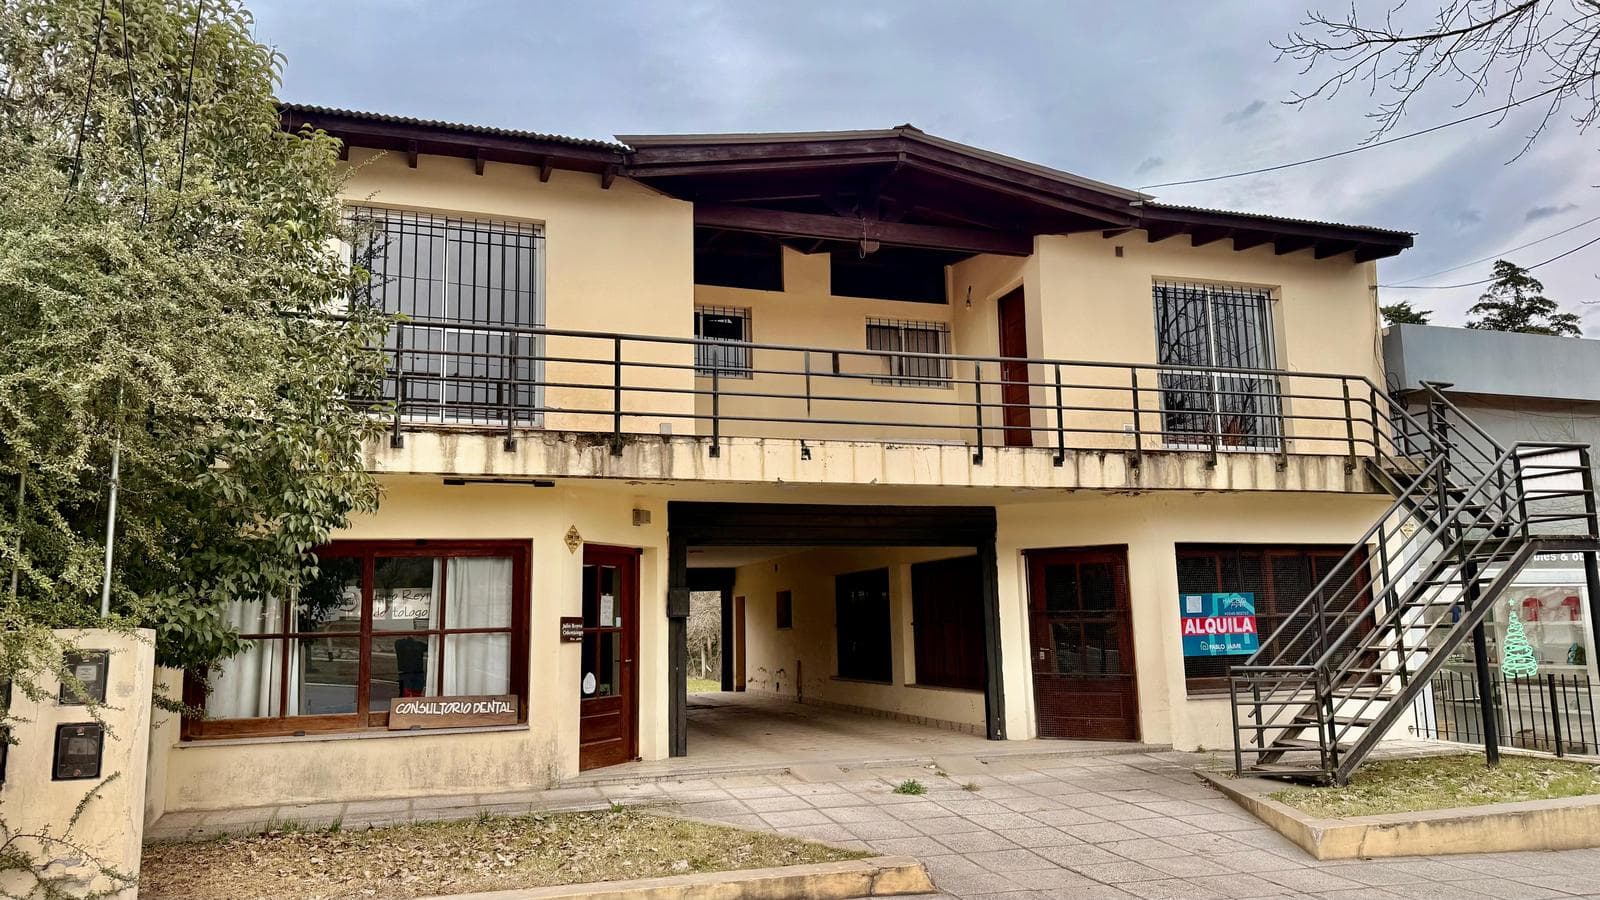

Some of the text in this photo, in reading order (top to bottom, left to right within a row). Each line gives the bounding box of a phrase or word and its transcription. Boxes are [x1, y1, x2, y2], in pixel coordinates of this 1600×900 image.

[402, 589, 432, 602] Reyn
[1185, 617, 1253, 634] ALQUILA
[395, 700, 515, 715] CONSULTORIO DENTAL
